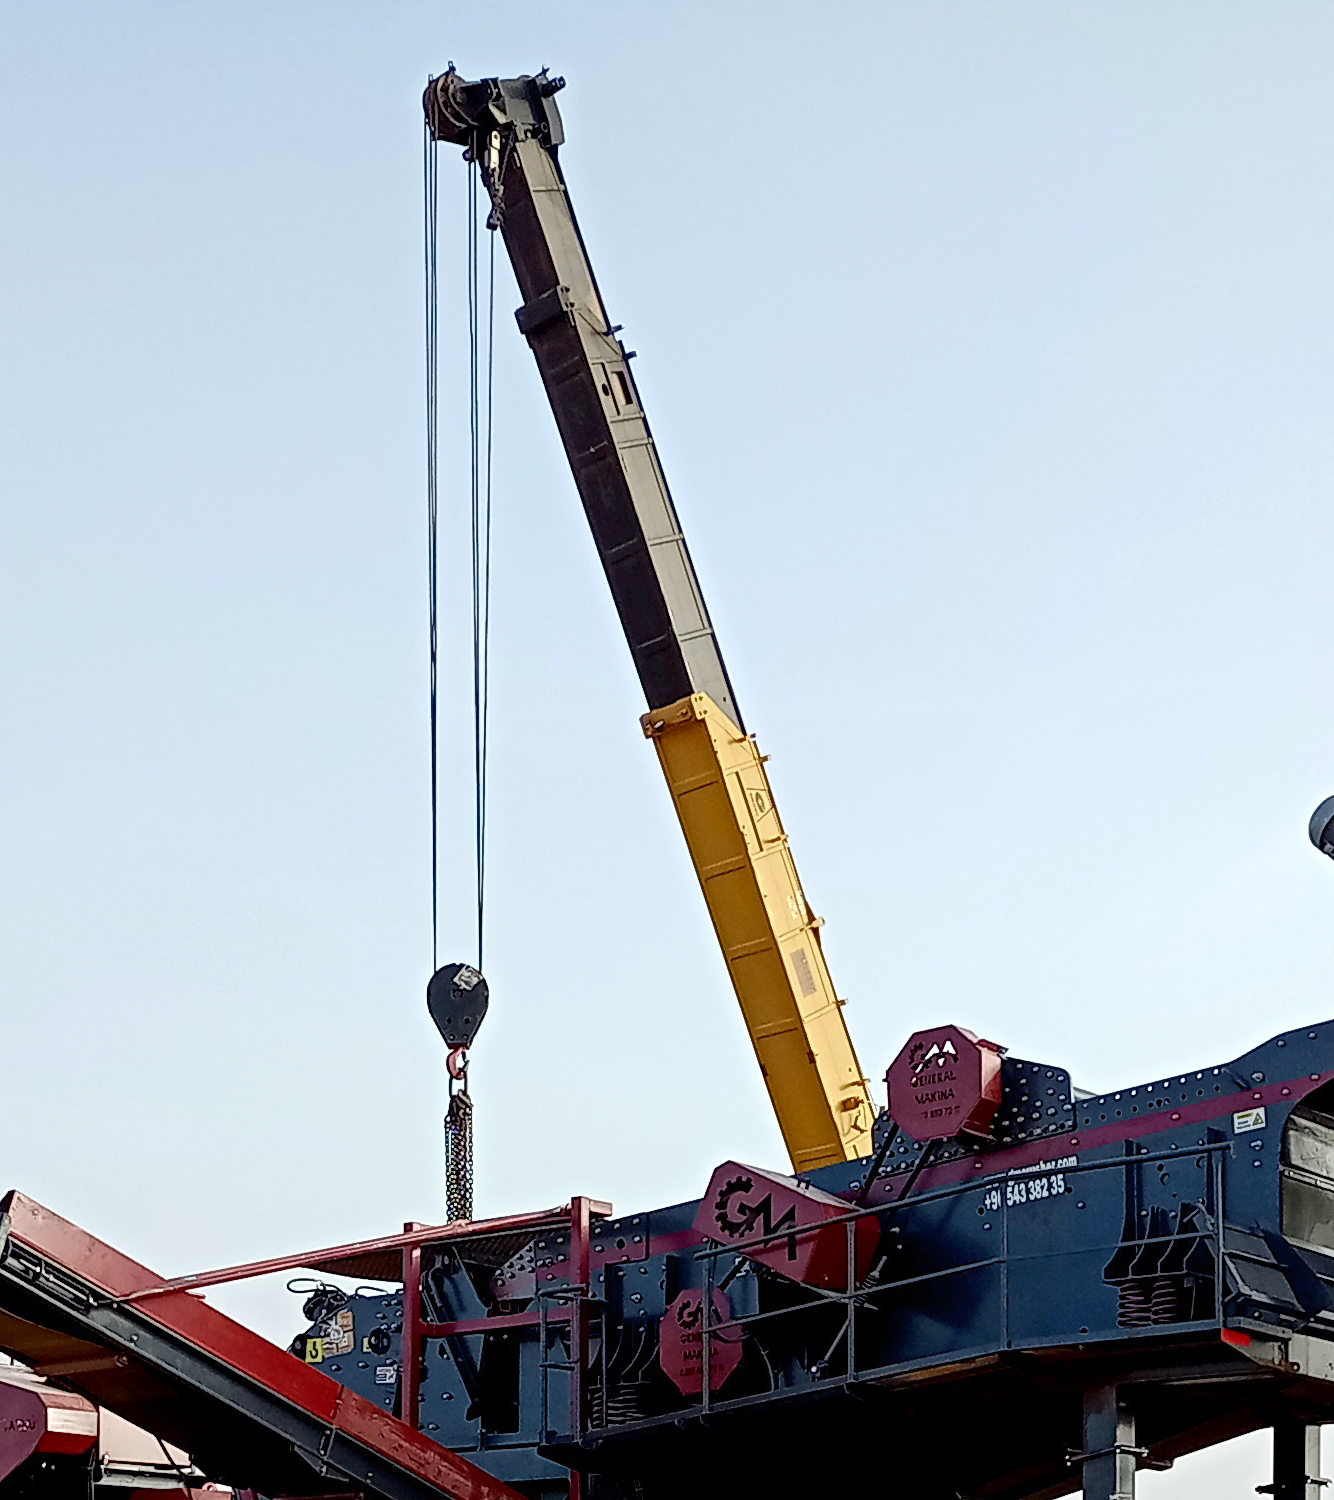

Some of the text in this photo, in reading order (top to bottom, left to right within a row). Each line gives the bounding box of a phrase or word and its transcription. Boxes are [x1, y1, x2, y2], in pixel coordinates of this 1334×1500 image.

[911, 1070, 956, 1087] GENERAL
[1007, 1182, 1027, 1206] 543
[1028, 1178, 1049, 1201] 382
[1050, 1174, 1065, 1195] 35
